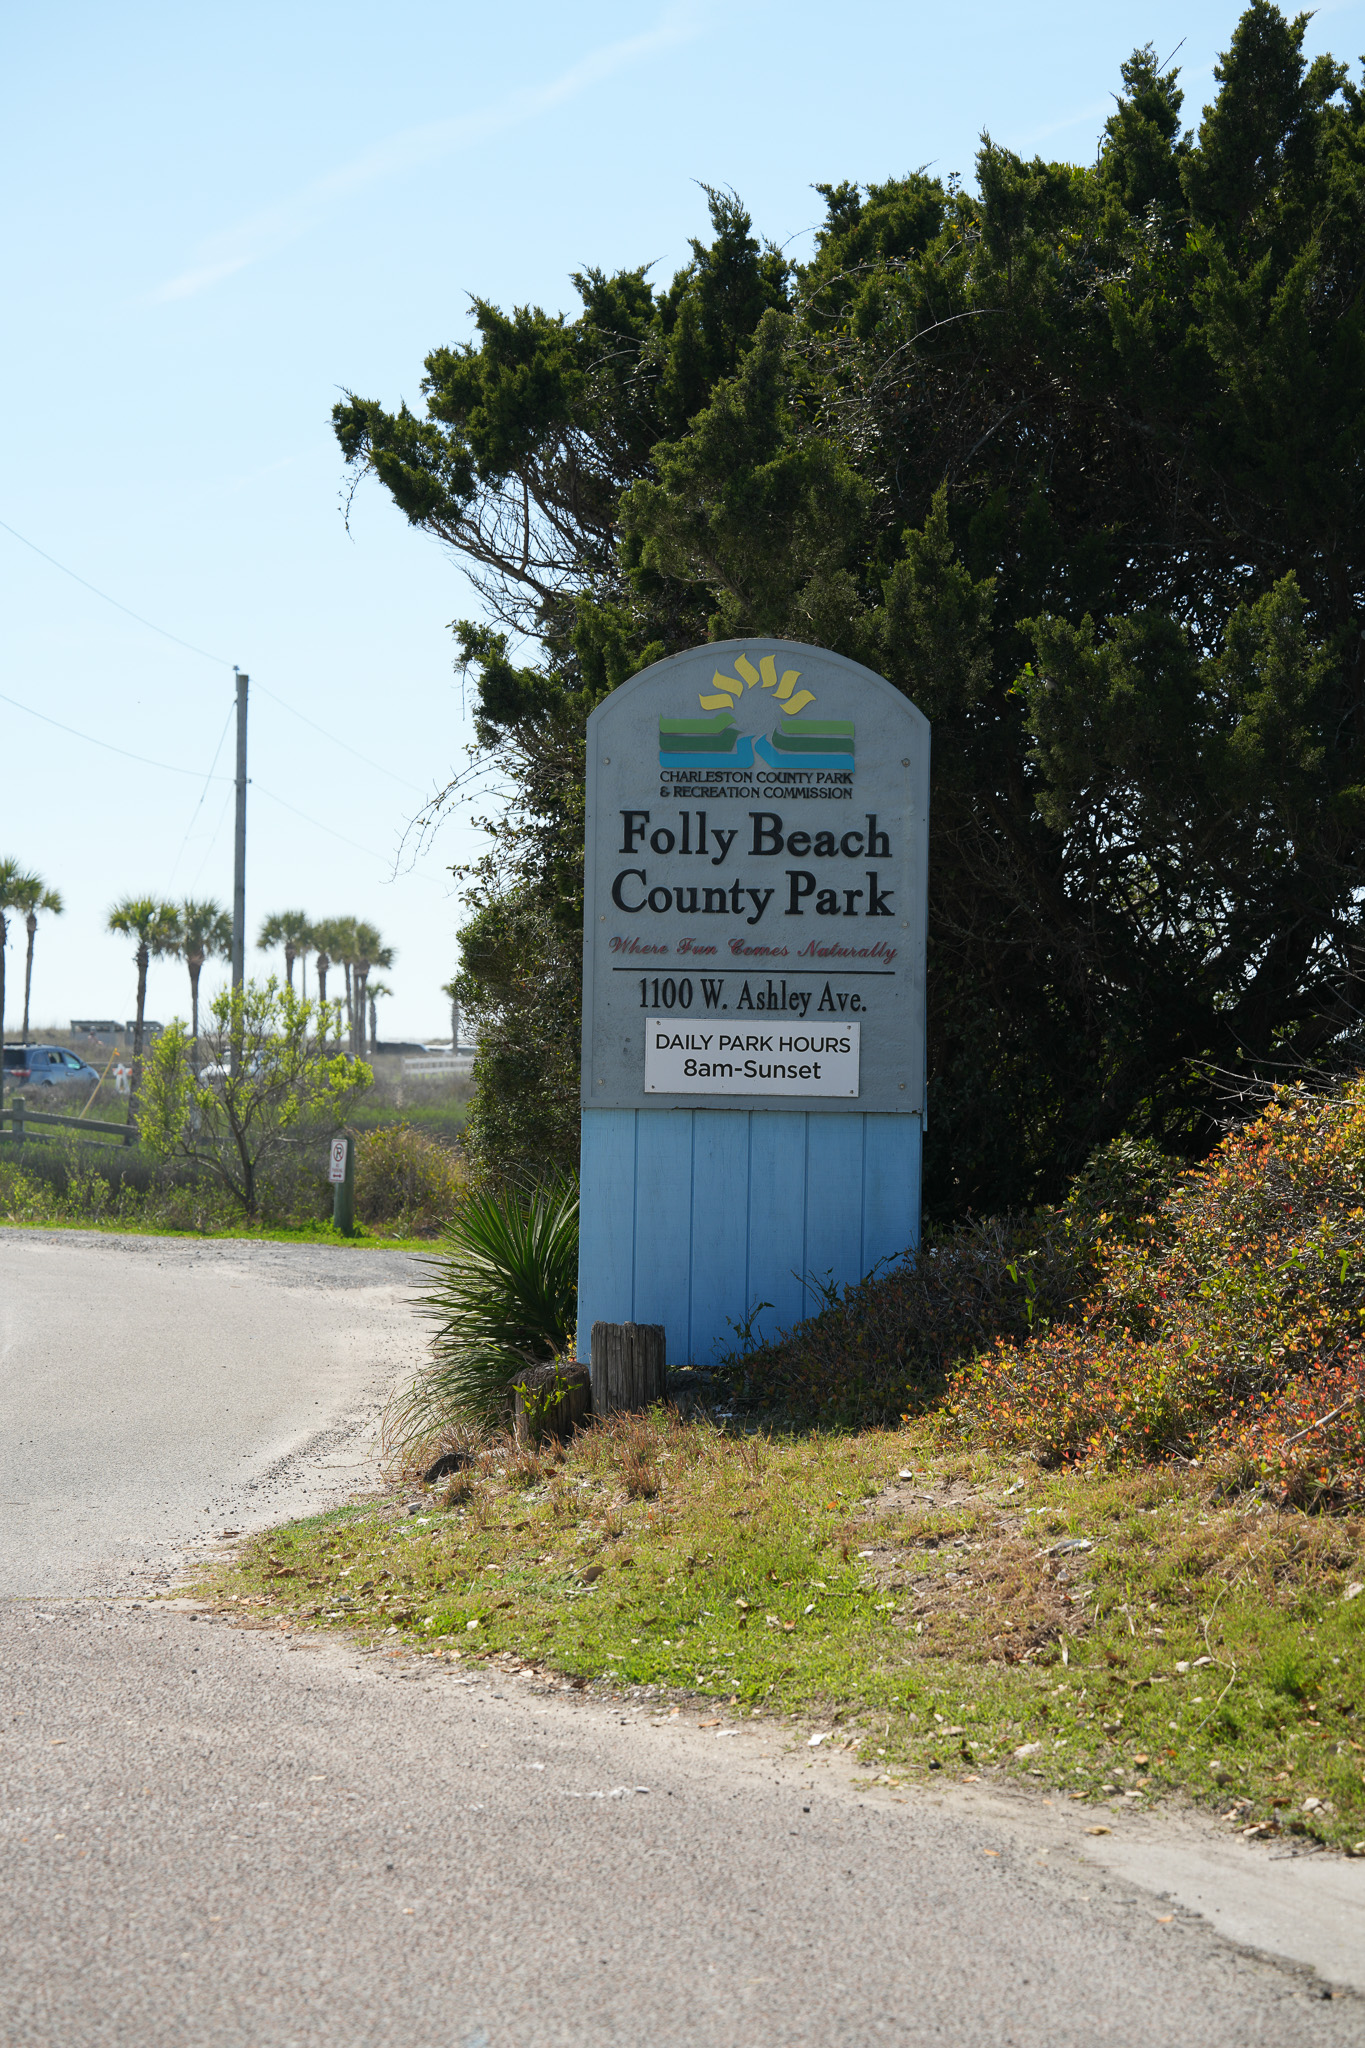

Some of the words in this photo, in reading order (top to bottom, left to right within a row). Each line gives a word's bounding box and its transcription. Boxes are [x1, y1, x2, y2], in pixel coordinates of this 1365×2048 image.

[659, 770, 753, 784] CHARLESTON
[756, 771, 813, 784] COUNTY
[816, 772, 854, 785] PARK
[659, 786, 671, 798] &
[673, 786, 760, 799] RECREATION
[763, 786, 853, 800] COMMISSION
[618, 809, 738, 866] Folly
[747, 811, 893, 858] Beach
[611, 868, 775, 925] County
[784, 870, 896, 917] Park
[608, 936, 668, 955] Where
[676, 937, 718, 956] Fun
[727, 938, 790, 957] Comes
[797, 940, 898, 965] Naturally
[639, 977, 694, 1009] 1100
[700, 978, 728, 1010] W.
[736, 980, 812, 1018] Ashley
[817, 980, 868, 1013] Ave.
[655, 1033, 714, 1050] DAILY
[719, 1035, 774, 1052] PARK
[779, 1037, 851, 1053] HOURS
[683, 1058, 822, 1080] 8am-Sunset
